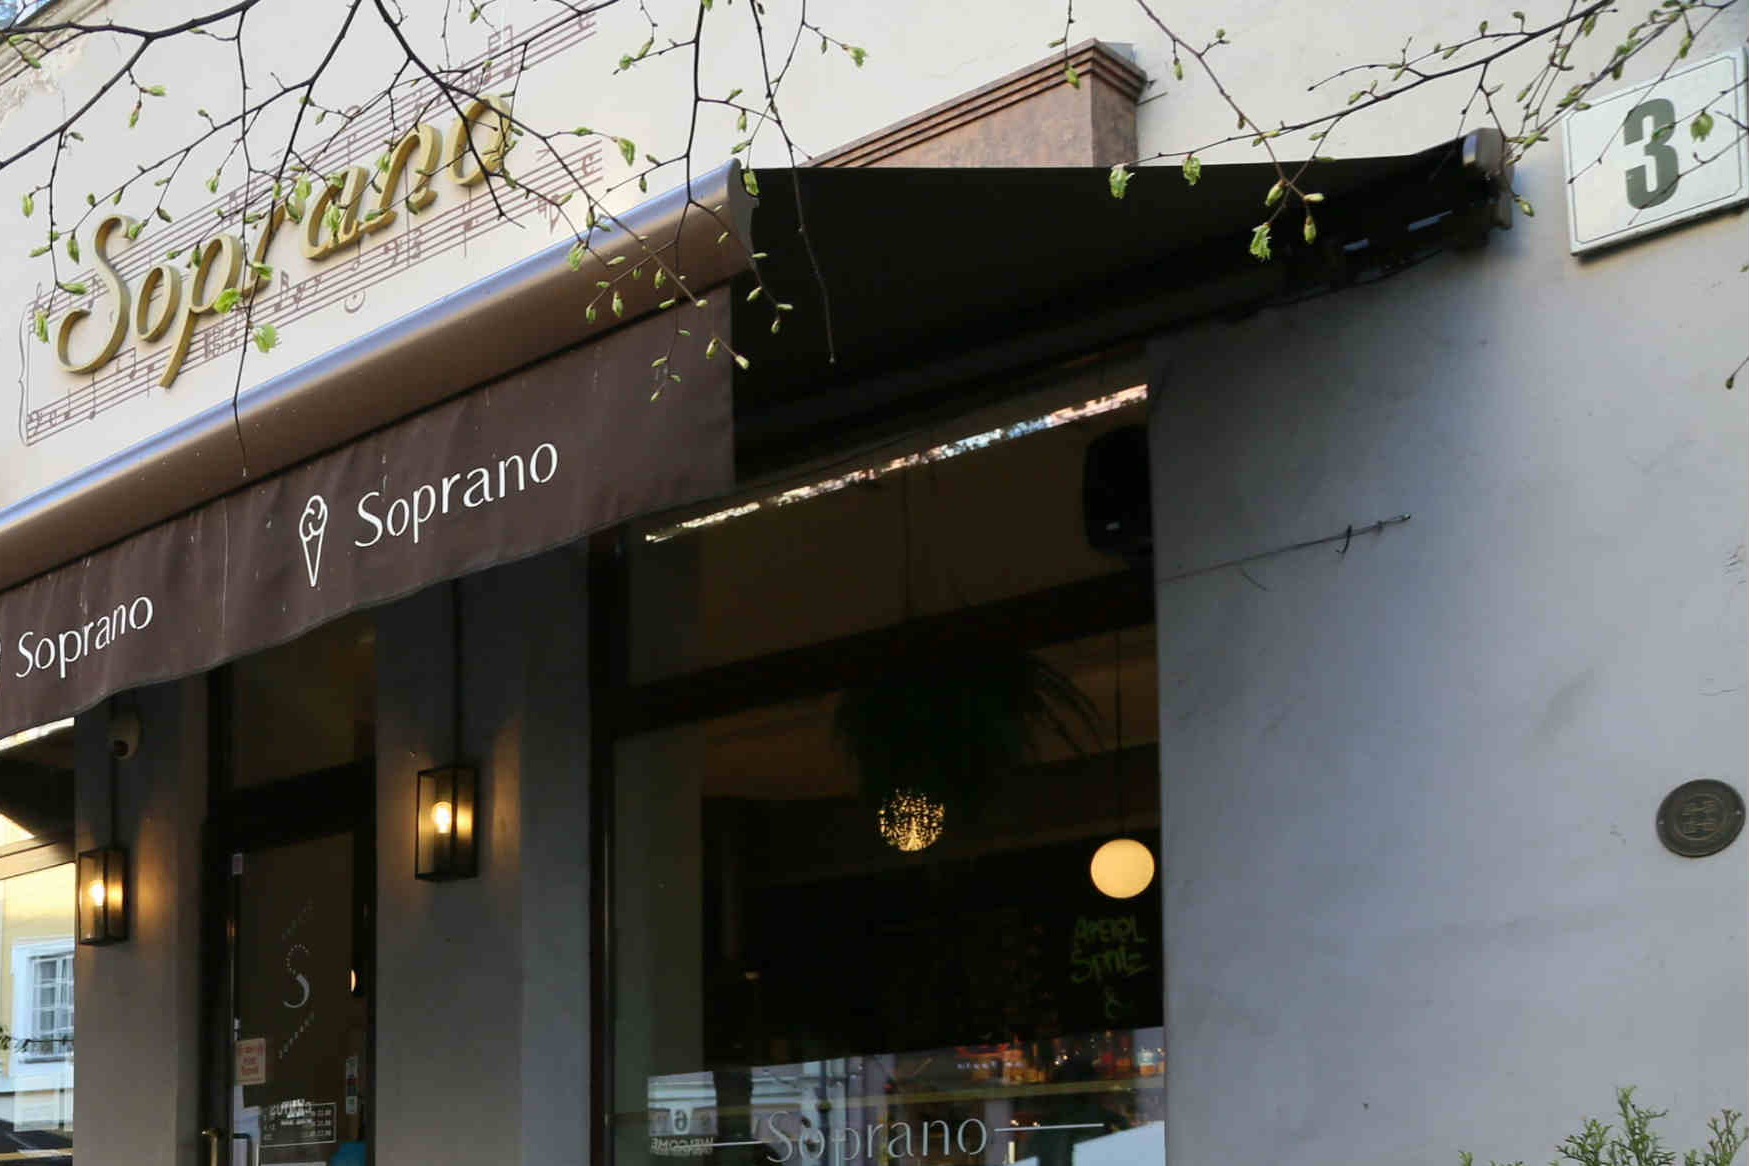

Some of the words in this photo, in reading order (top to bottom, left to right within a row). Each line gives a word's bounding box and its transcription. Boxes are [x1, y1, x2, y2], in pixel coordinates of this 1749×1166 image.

[1624, 98, 1680, 209] 3
[57, 94, 512, 389] Soprano
[354, 443, 558, 547] Soprano
[15, 596, 153, 679] Soprano
